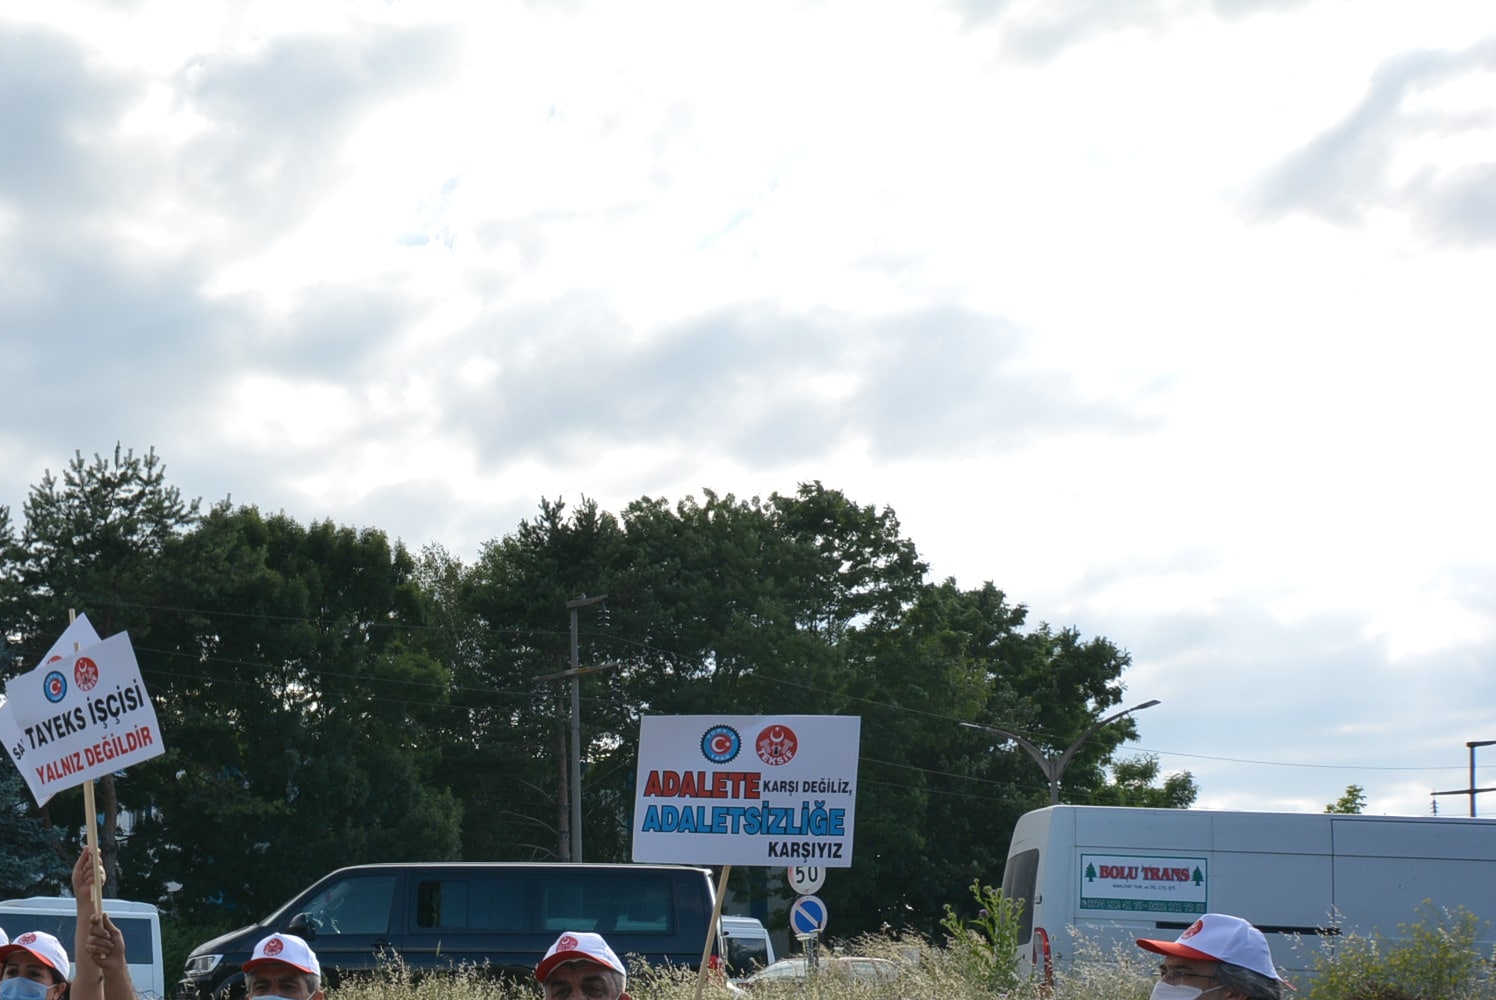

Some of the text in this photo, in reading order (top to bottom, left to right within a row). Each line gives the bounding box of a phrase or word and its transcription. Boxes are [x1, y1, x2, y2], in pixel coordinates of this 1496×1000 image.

[25, 678, 145, 750] TAYEKS İŞÇİSİ
[35, 724, 154, 785] YALNIZ DEĞİLDİR
[643, 770, 853, 799] ADALETE KARŞI DEĞİLİZ,
[641, 800, 846, 836] ADALETSİZLİĞE
[767, 841, 843, 863] KARŞIYIZ
[795, 866, 818, 884] 50
[1099, 865, 1190, 881] BOLU TRANS
